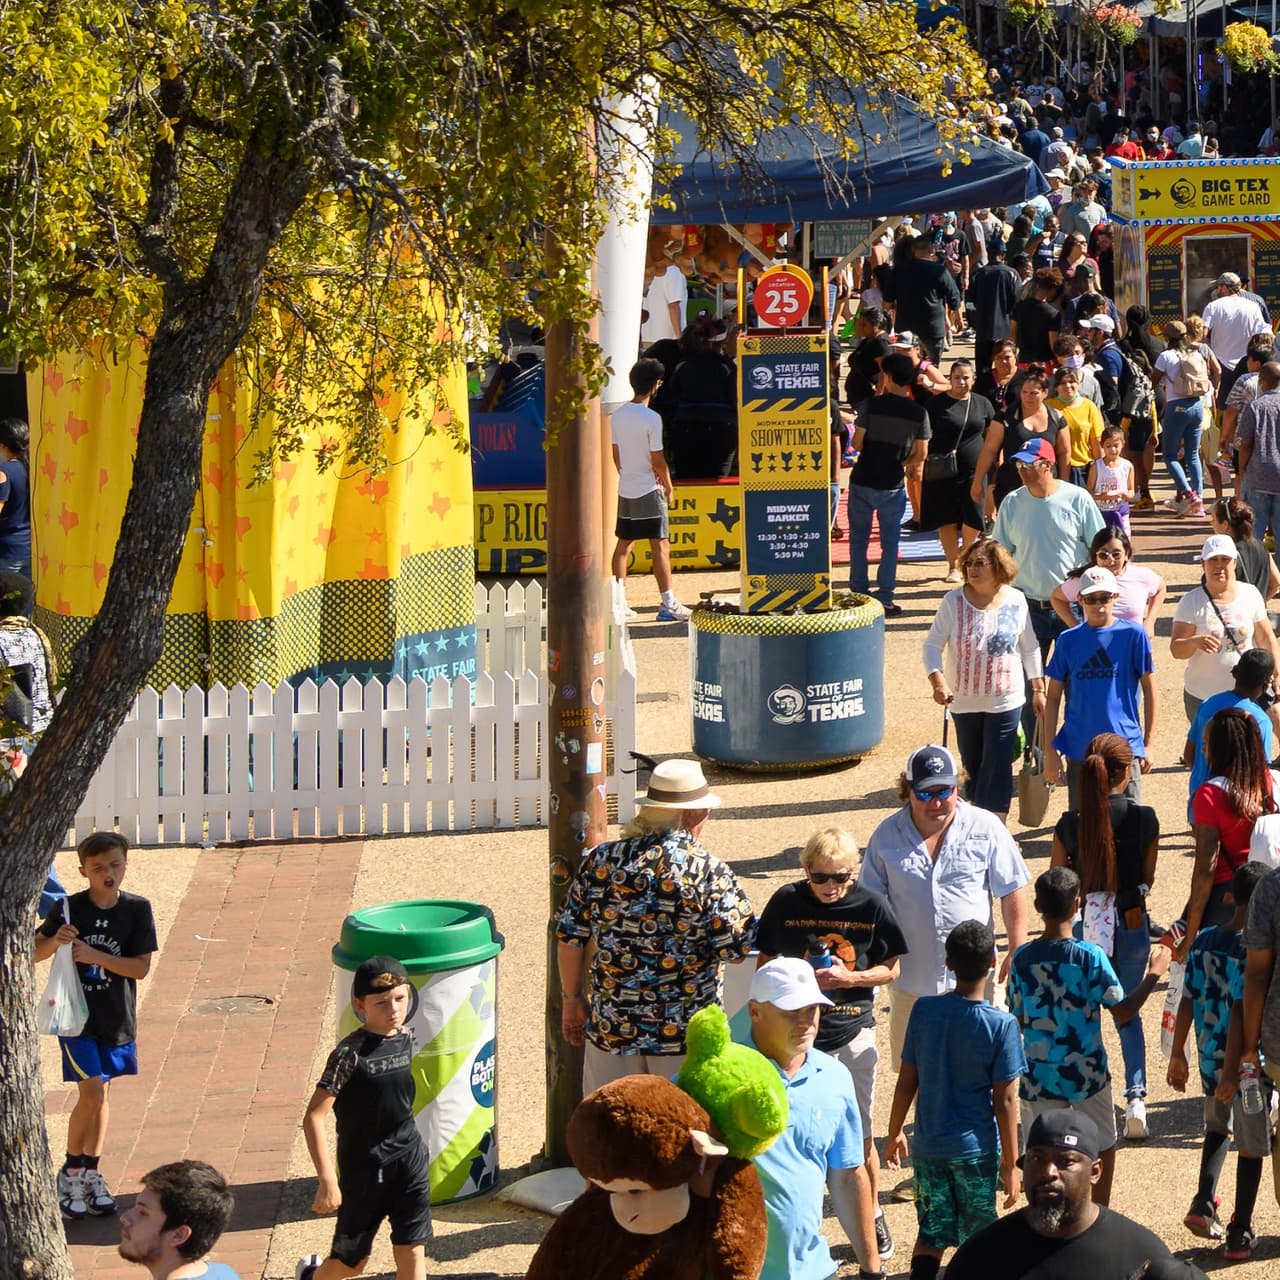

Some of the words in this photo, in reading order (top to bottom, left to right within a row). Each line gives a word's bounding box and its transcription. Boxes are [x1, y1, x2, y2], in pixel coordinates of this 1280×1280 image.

[1201, 179, 1232, 192] BIG
[1235, 178, 1270, 191] TEX
[1201, 194, 1235, 207] GAME
[1239, 192, 1271, 206] CARD
[764, 289, 800, 314] 25
[774, 364, 800, 373] STATE
[801, 362, 820, 372] FAIR
[477, 423, 517, 452] FOLKS!
[750, 427, 823, 447] SHOWTIMES
[668, 498, 697, 511] UN
[766, 504, 811, 513] MIDWAY
[503, 503, 547, 542] RIG
[767, 514, 810, 522] BARKER
[668, 532, 696, 545] UN
[757, 533, 777, 541] 12:30
[783, 532, 798, 540] 1:30
[769, 542, 786, 550] 3:30
[791, 541, 809, 549] 4:30
[774, 551, 791, 559] 5:30
[791, 550, 804, 559] PM
[412, 663, 448, 679] STATE
[452, 657, 476, 678] FAIR
[704, 683, 722, 698] FAIR
[806, 683, 841, 698] STATE
[842, 678, 863, 693] FAIR
[832, 694, 844, 702] OF
[818, 920, 843, 929] DESERT
[843, 921, 876, 930] HIGHWAY
[83, 934, 122, 957] TROJAN
[473, 1054, 496, 1073] PLAS
[471, 1066, 496, 1086] BOTT
[480, 1081, 495, 1093] ON
